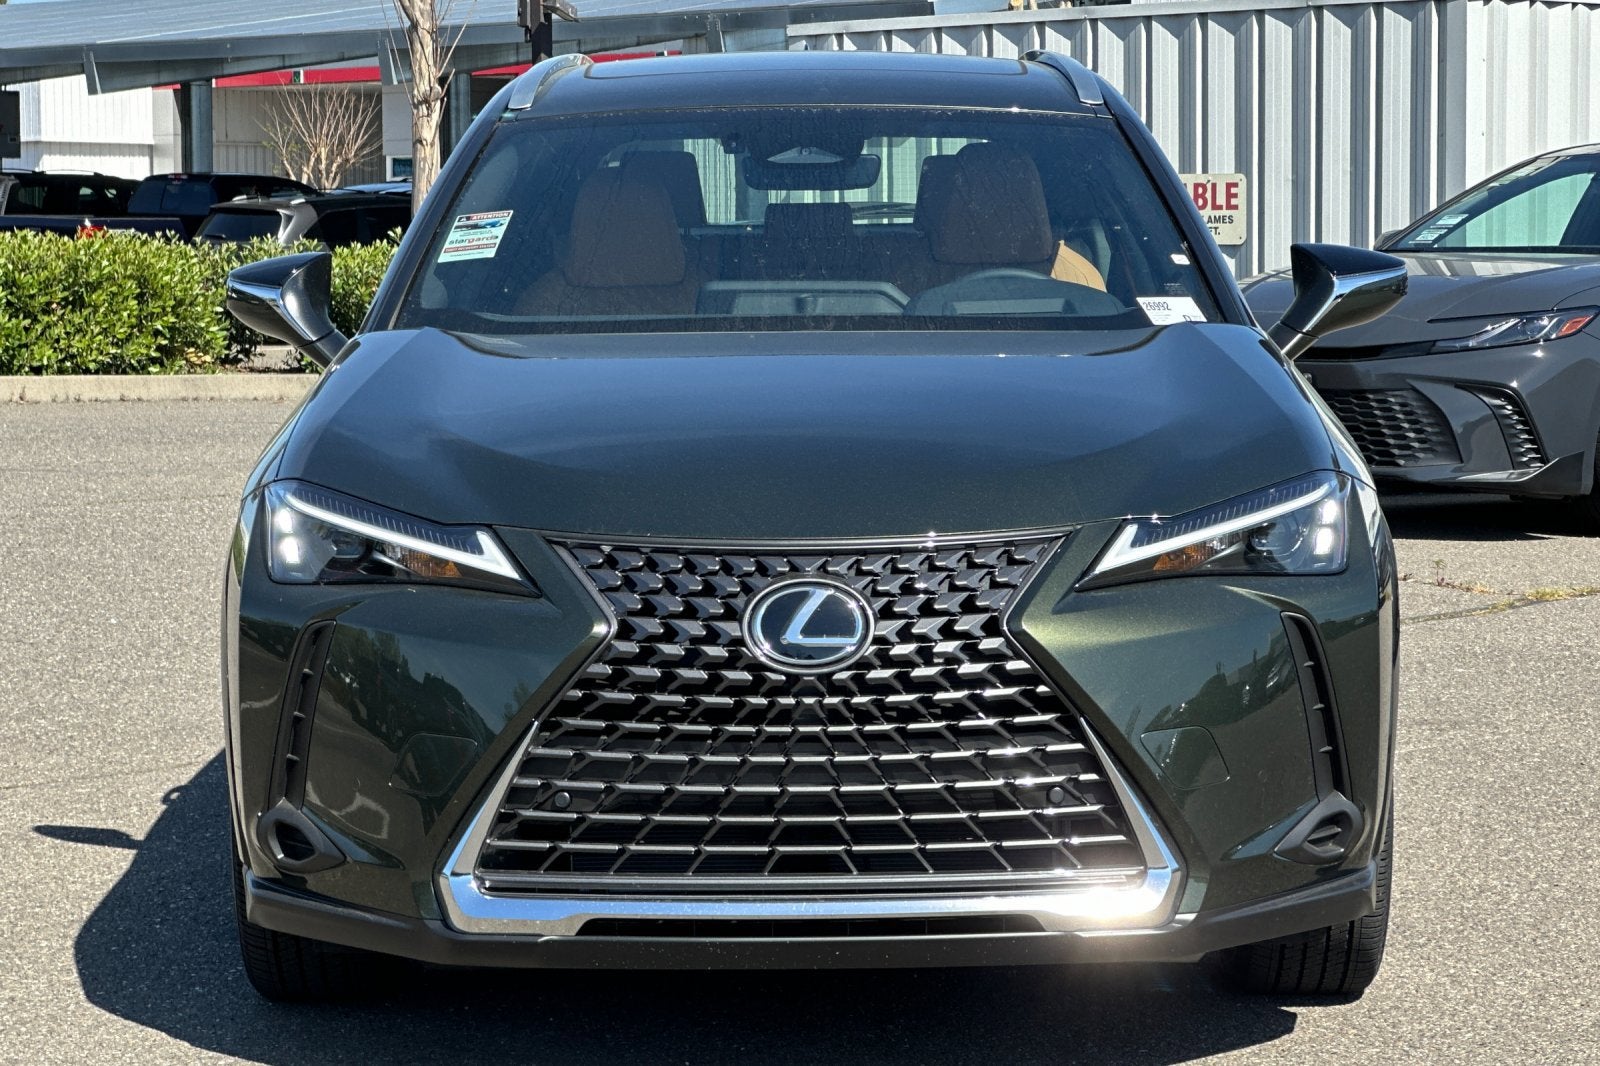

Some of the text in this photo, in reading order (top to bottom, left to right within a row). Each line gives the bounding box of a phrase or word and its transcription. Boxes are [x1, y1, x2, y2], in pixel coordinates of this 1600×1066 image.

[1184, 182, 1239, 211] BLE
[471, 212, 509, 220] ATTENTION
[1206, 215, 1234, 225] AMES
[1142, 301, 1172, 311] 26992
